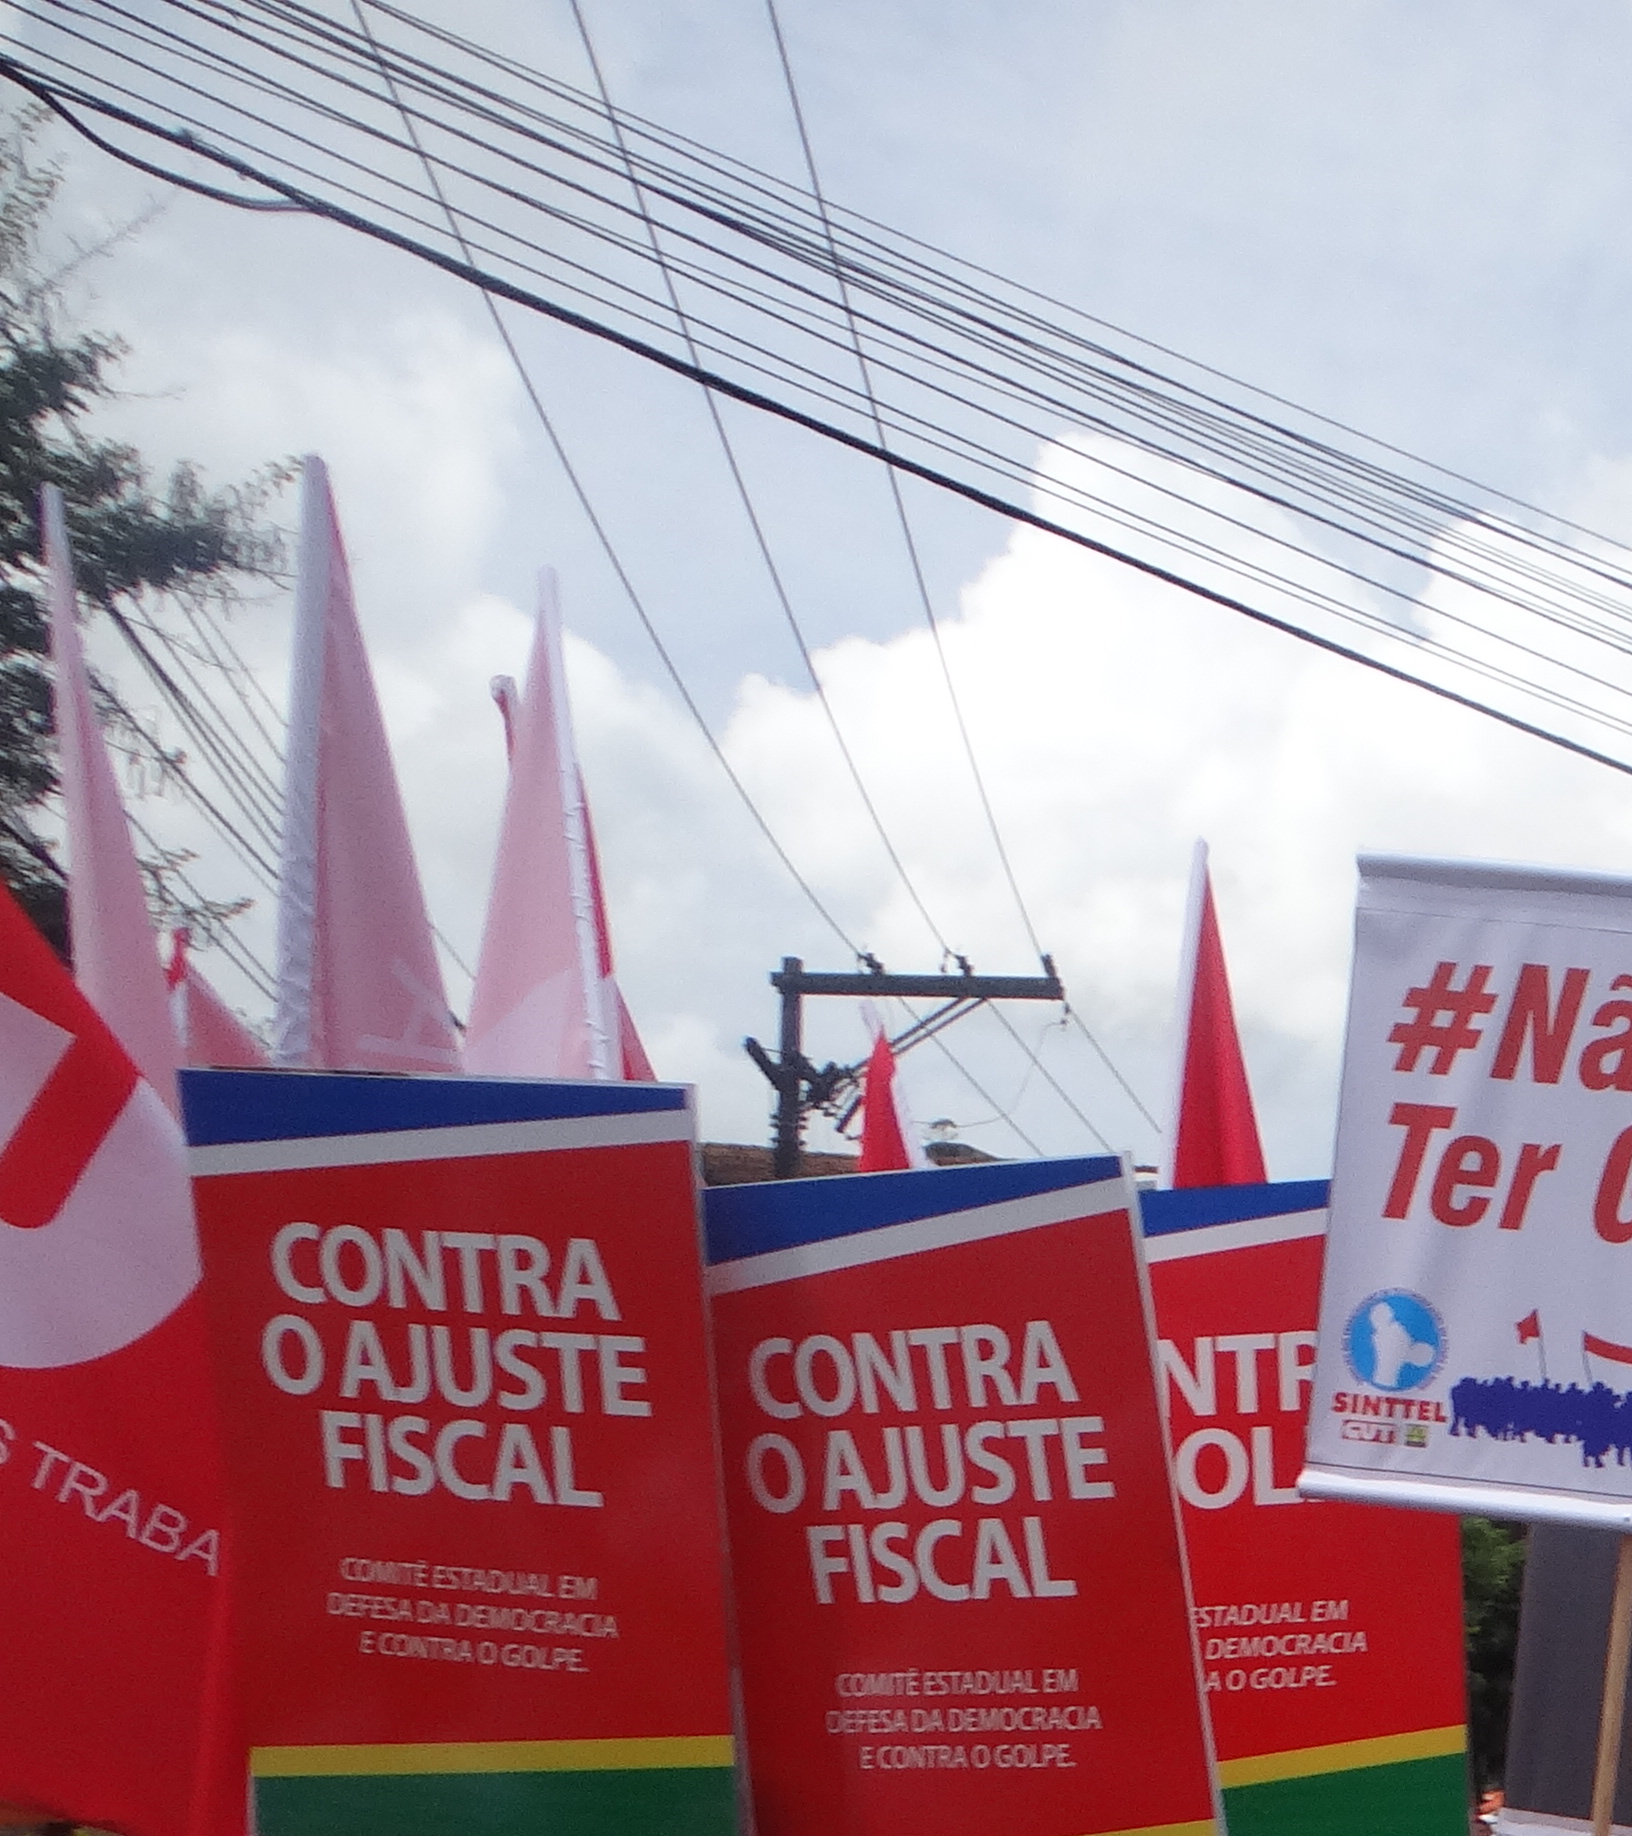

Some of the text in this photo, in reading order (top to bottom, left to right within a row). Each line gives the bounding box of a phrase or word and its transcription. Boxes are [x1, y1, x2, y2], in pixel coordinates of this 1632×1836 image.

[1381, 1102, 1561, 1231] Ter
[270, 1221, 622, 1322] CONTRA
[261, 1315, 652, 1417] O AJUSTE
[747, 1320, 1080, 1420] CONTRA
[1156, 1331, 1318, 1416] NTR
[1332, 1392, 1448, 1423] SINTTEL
[320, 1410, 605, 1507] FISCAL
[747, 1416, 1115, 1514] O AJUSTE
[805, 1516, 1078, 1604] FISCAL
[431, 1565, 556, 1598] ESTADUAL
[557, 1575, 600, 1601] EM
[326, 1592, 620, 1639] DEFESA DA DEMOCRACIA
[1311, 1600, 1349, 1623] EM
[359, 1630, 591, 1673] E CONTRA O GOLPE.
[1205, 1632, 1367, 1660] DEMOCRACIA
[922, 1669, 1040, 1696] ESTADUAL
[1042, 1668, 1080, 1693] EM
[1226, 1669, 1247, 1692] O
[1250, 1665, 1337, 1690] GOLPE.
[825, 1706, 1103, 1734] DEFESA DA DEMOCRACIA
[858, 1744, 1078, 1770] E CONTRA O GOLPE.
